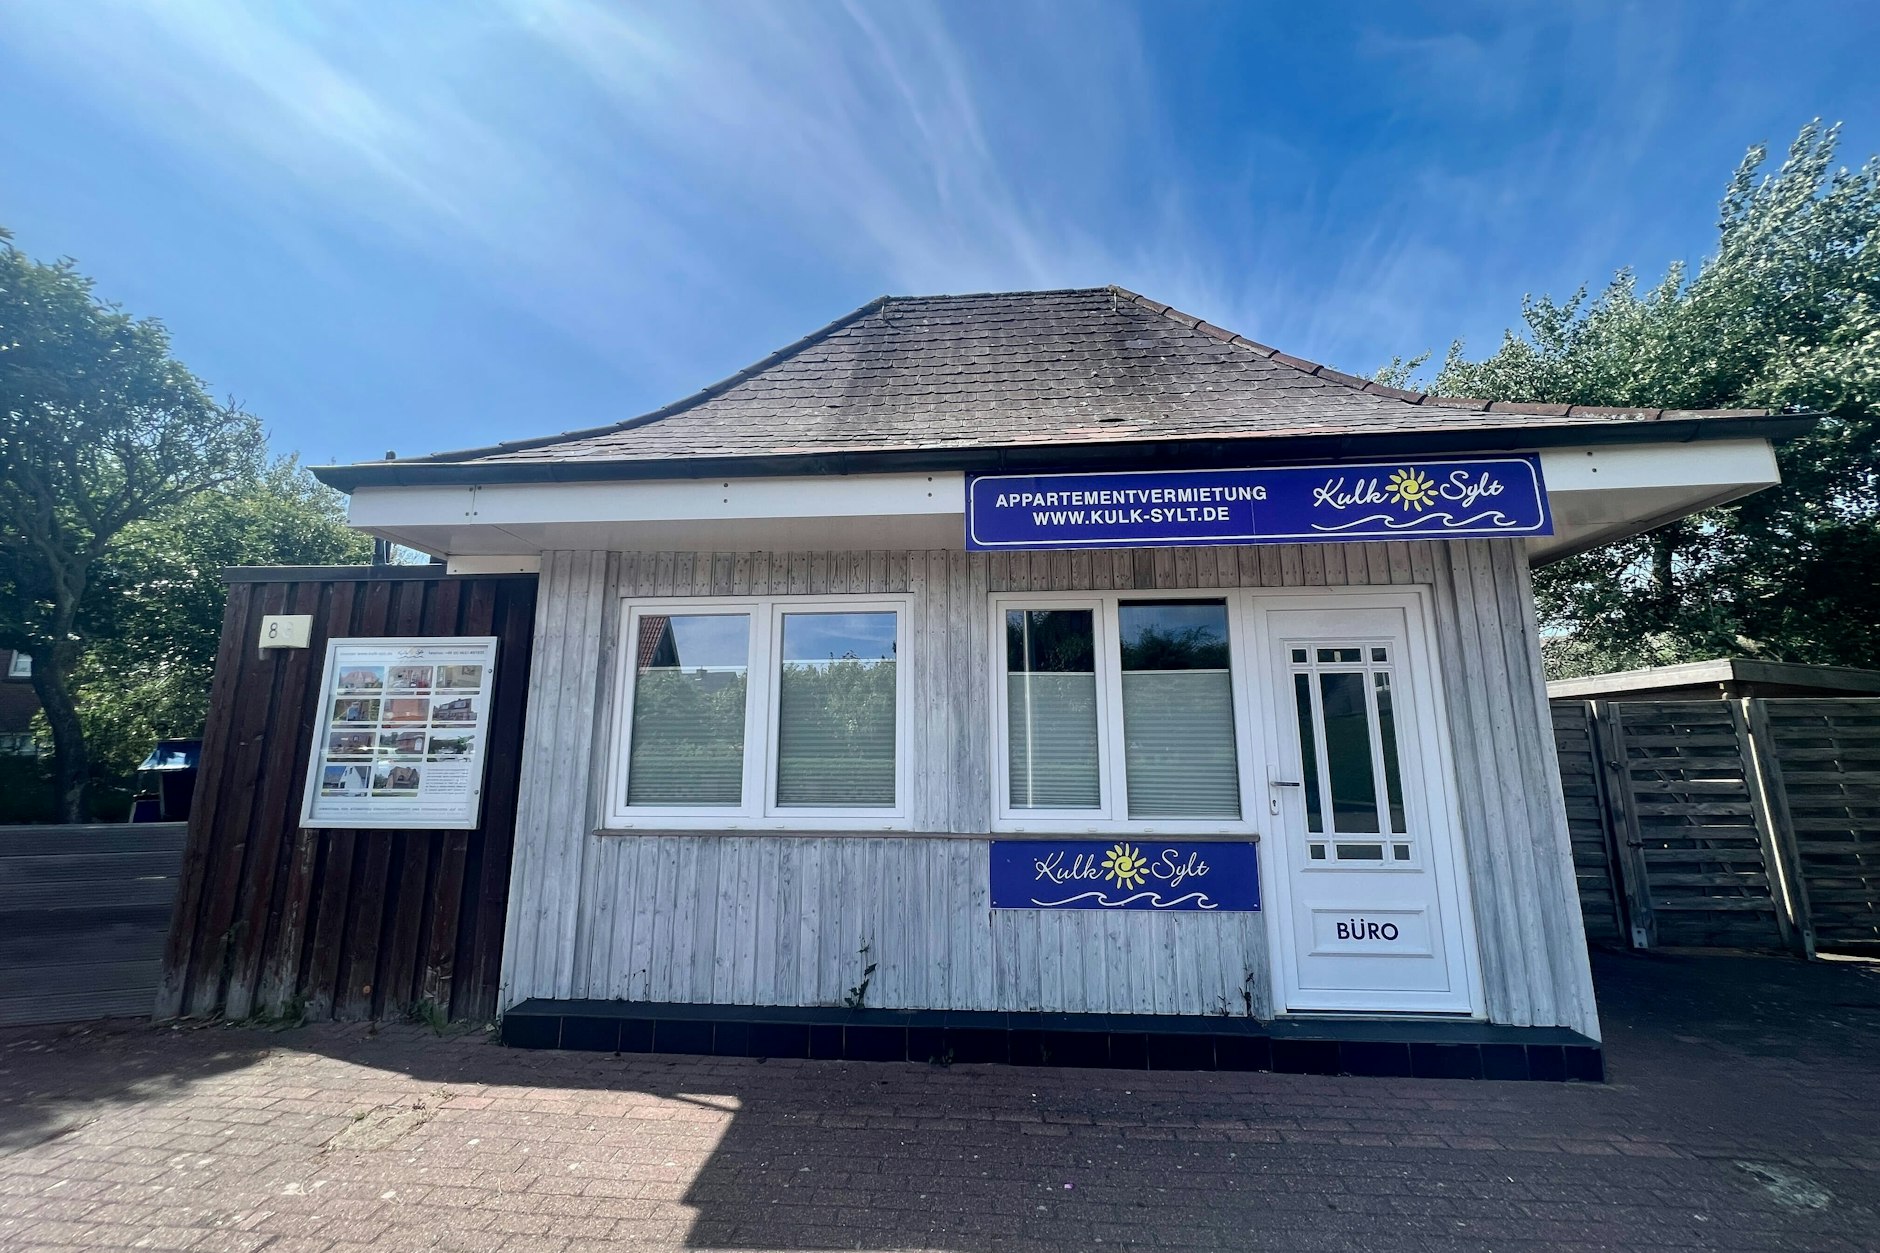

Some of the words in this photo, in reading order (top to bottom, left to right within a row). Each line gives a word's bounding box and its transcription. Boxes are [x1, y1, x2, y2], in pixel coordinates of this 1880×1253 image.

[996, 485, 1267, 508] APPARTEMENTVERMIETUNG
[1312, 476, 1390, 510] Kulk
[1439, 470, 1505, 508] Sylt
[1033, 506, 1230, 526] WWW.KULK-SYLT.DE
[1034, 850, 1104, 884] Kulk
[1151, 849, 1210, 887] Sylt
[1336, 918, 1399, 941] BÜRO
